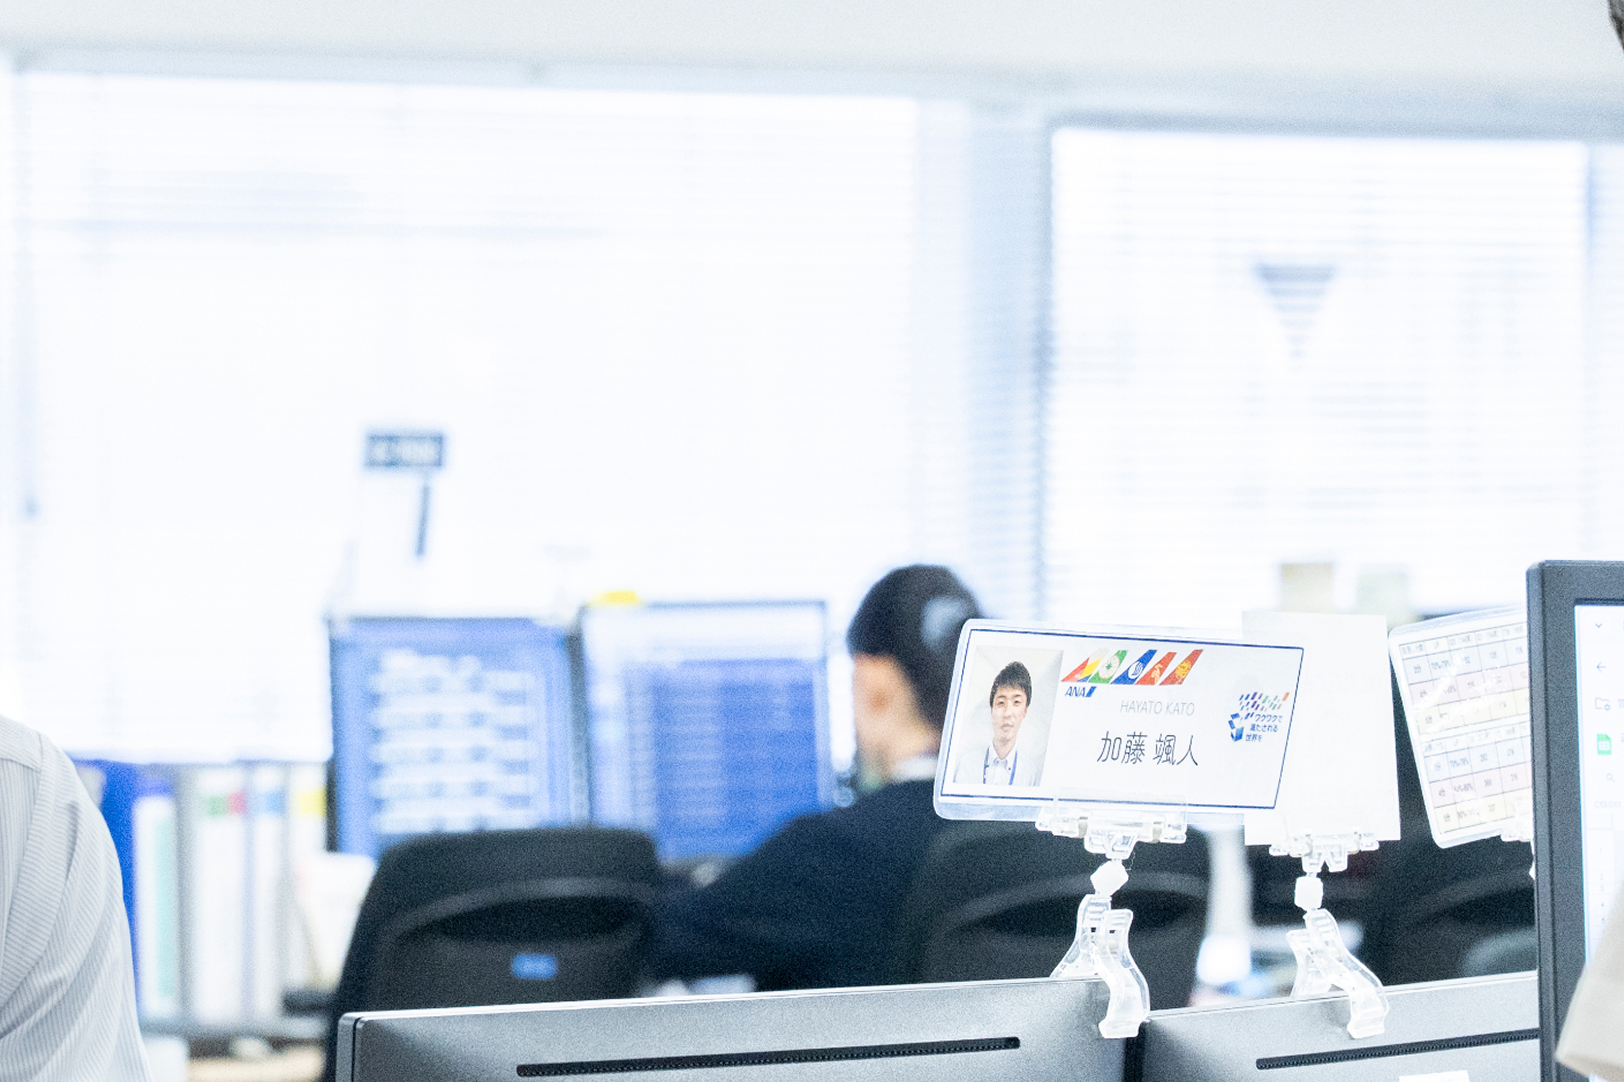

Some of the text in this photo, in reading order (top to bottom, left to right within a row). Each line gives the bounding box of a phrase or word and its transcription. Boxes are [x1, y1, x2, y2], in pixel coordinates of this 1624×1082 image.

[1065, 686, 1086, 697] ANA
[1120, 700, 1195, 716] HAYATO KATO
[1097, 731, 1198, 766] 加藤 颯人
